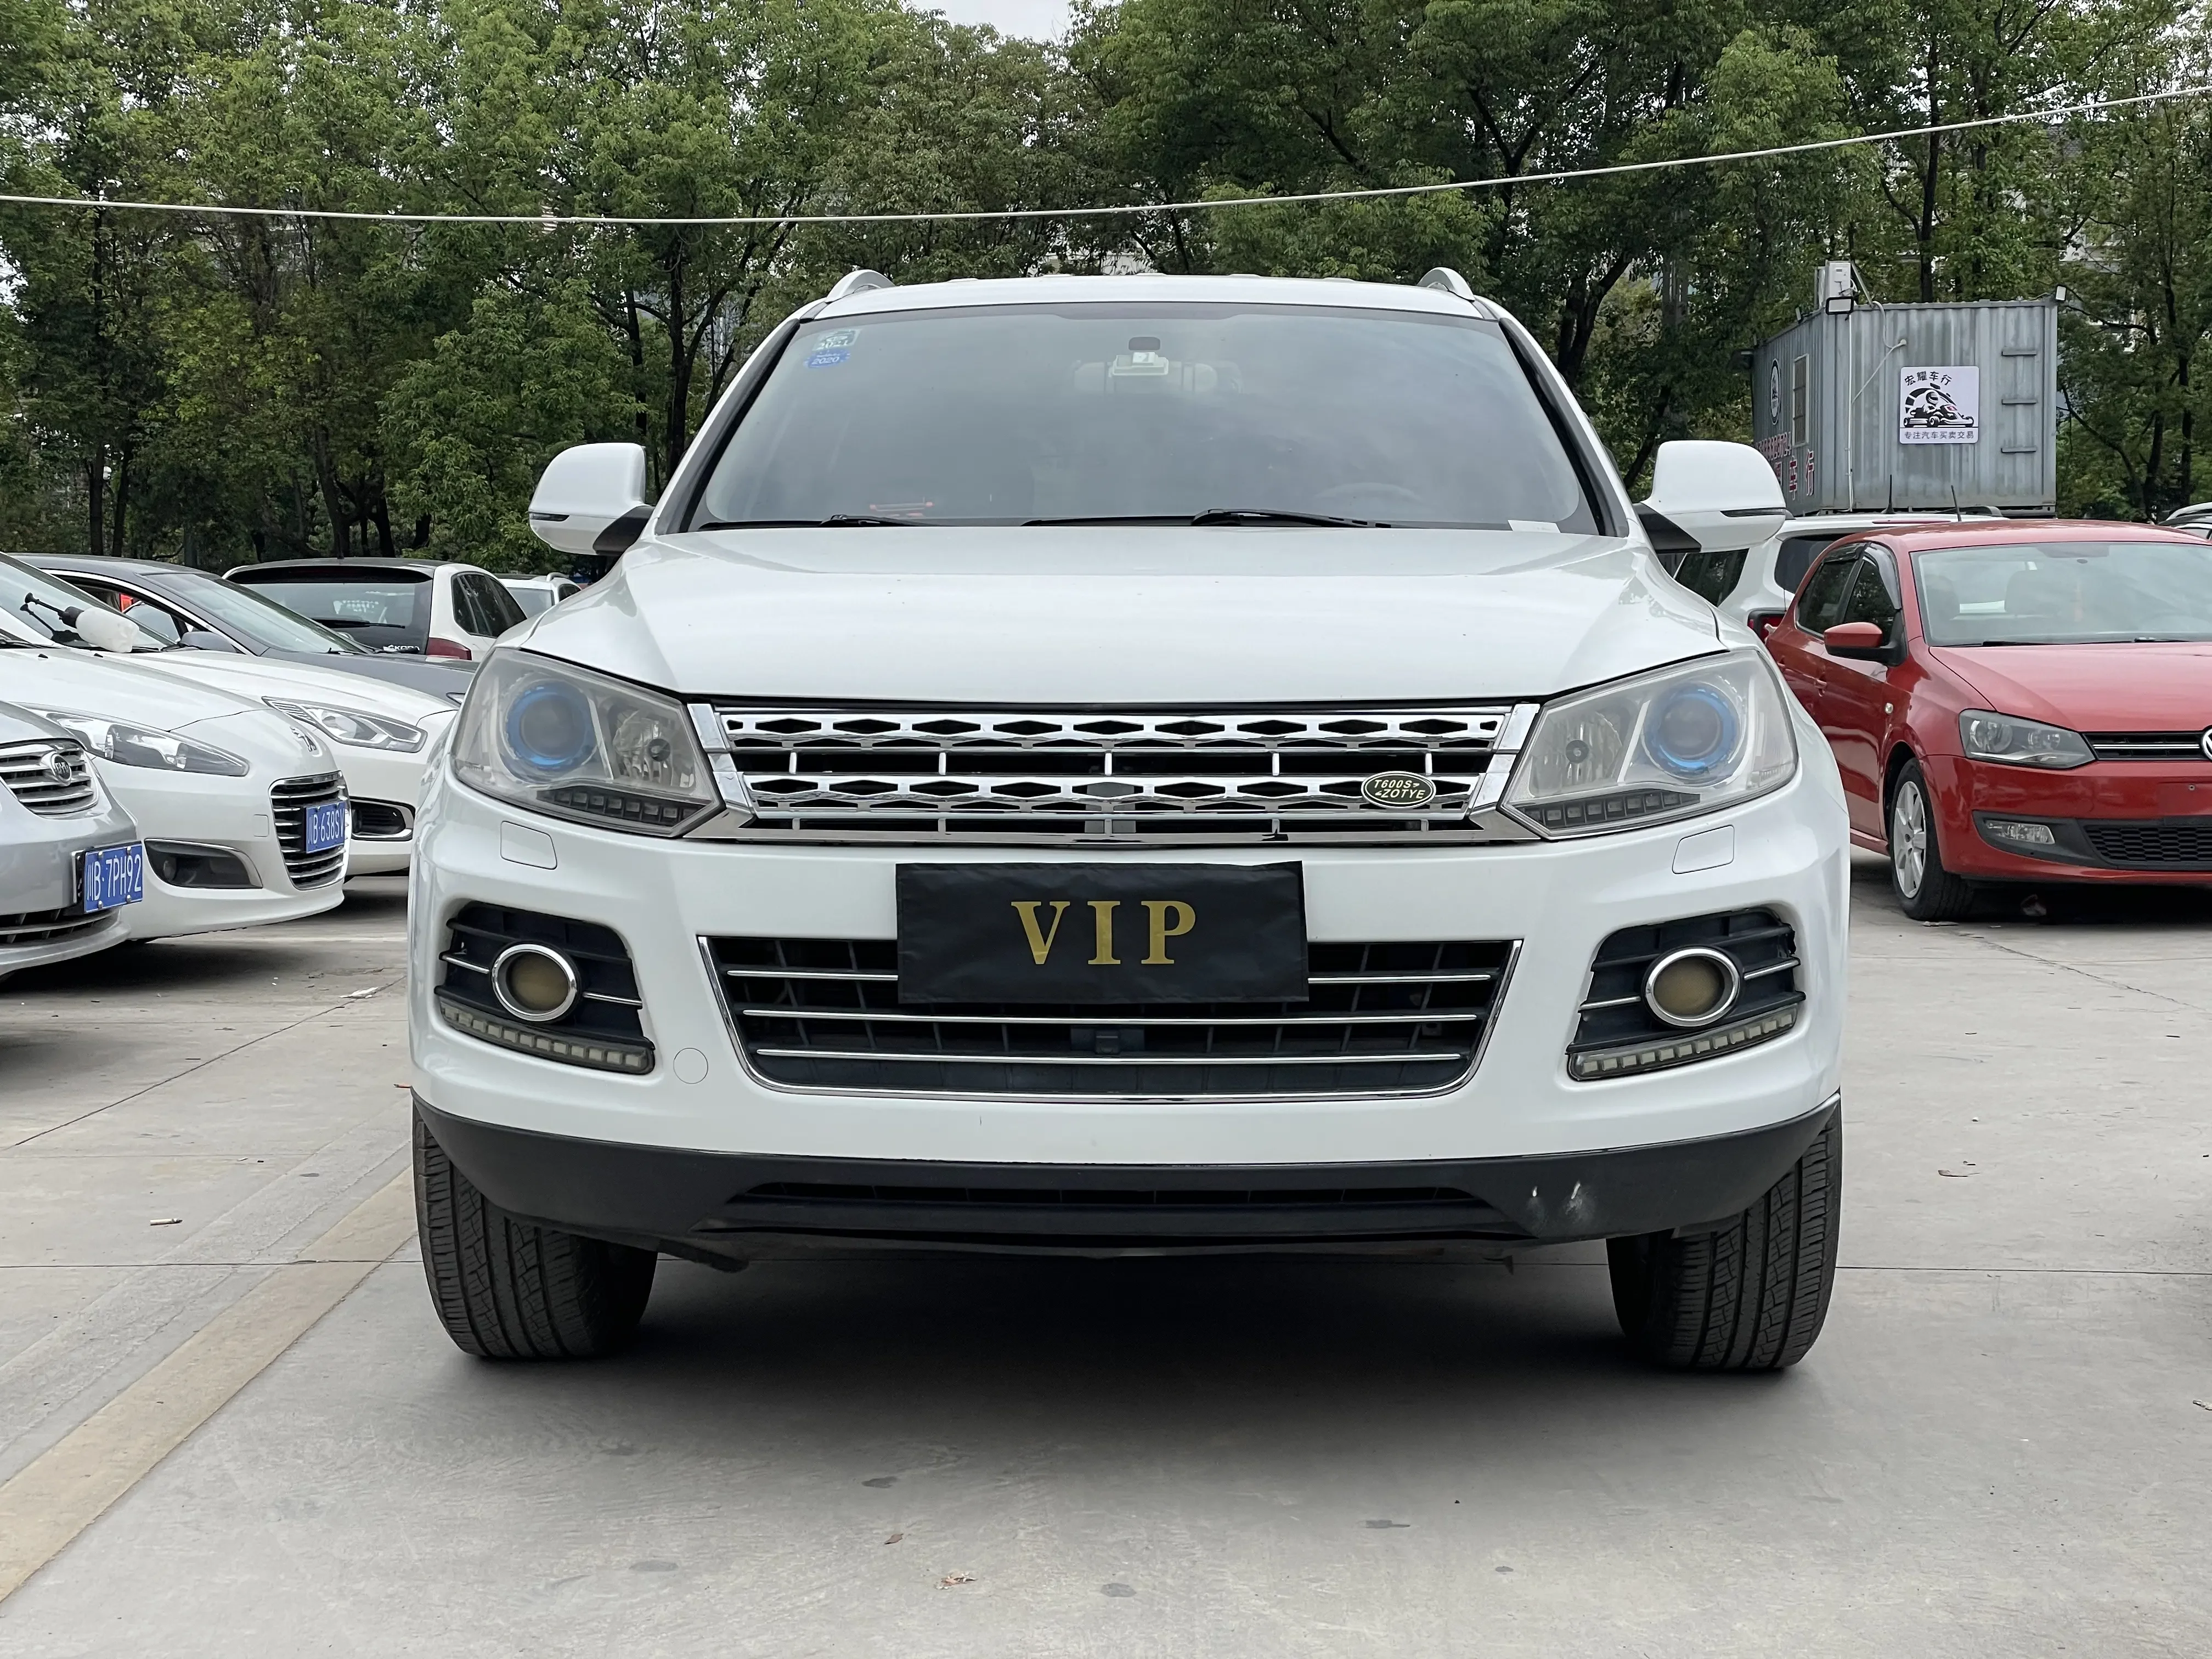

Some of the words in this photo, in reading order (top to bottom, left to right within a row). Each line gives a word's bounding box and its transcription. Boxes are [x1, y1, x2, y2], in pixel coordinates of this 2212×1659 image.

[811, 357, 839, 365] 2020
[1904, 371, 1952, 386] 宏耀车行
[1904, 431, 1974, 439] 专注汽车买卖交易
[55, 762, 69, 774] BYD
[1374, 780, 1412, 789] T600S
[1381, 788, 1425, 799] ZOTYE
[1011, 900, 1197, 966] VIP
